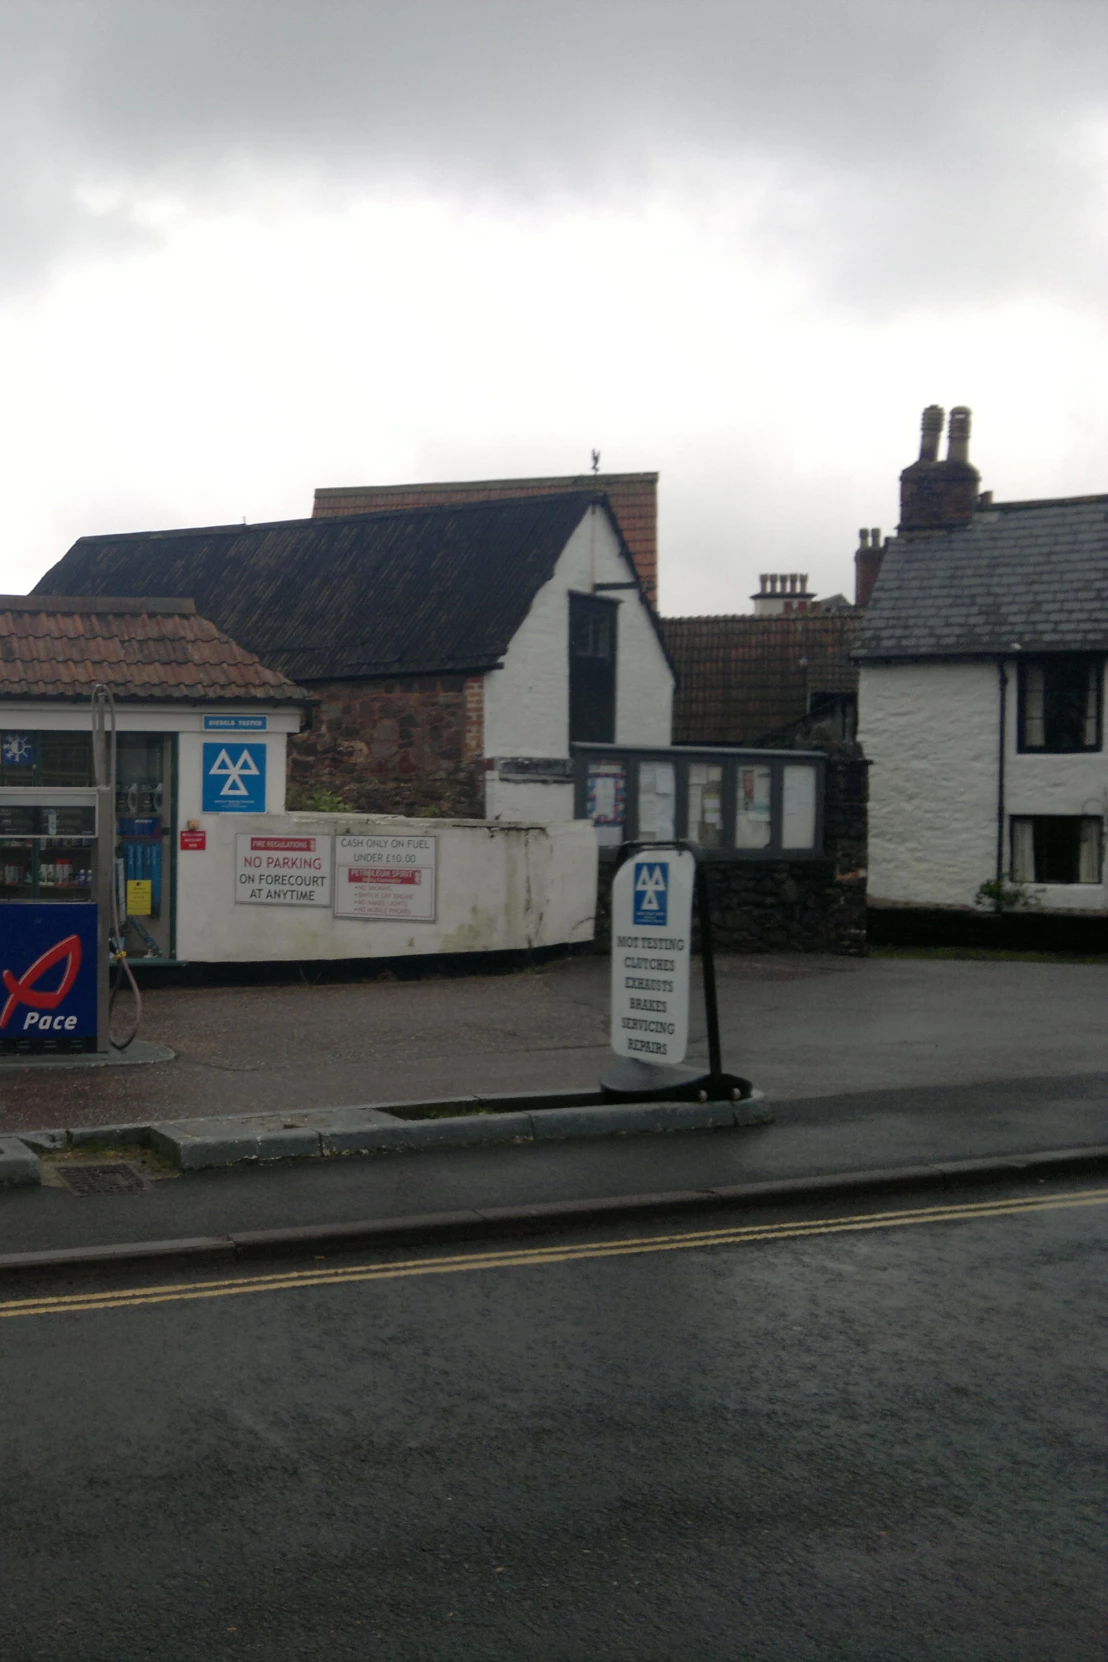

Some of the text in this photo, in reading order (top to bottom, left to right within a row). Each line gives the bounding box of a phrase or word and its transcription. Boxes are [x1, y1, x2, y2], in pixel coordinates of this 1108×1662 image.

[208, 719, 263, 727] DIESELS TESTED
[252, 840, 308, 850] FIRE REGULATIONS
[340, 838, 430, 849] CASH ONLY ON FUEL
[243, 856, 322, 870] NO PARKING
[353, 853, 417, 863] UNDER £10.00
[350, 869, 391, 877] PETROLEUM
[239, 874, 327, 887] ON FORECOURT
[249, 889, 316, 901] AT ANYTIME
[616, 935, 685, 951] MOT TESTING
[623, 956, 675, 972] CLUTCHES
[624, 976, 674, 992] EXHAUSTS
[629, 997, 668, 1013] BRAKES
[22, 1011, 78, 1031] Pace
[621, 1017, 675, 1035] SERVICING
[627, 1038, 668, 1056] REPAIRS
